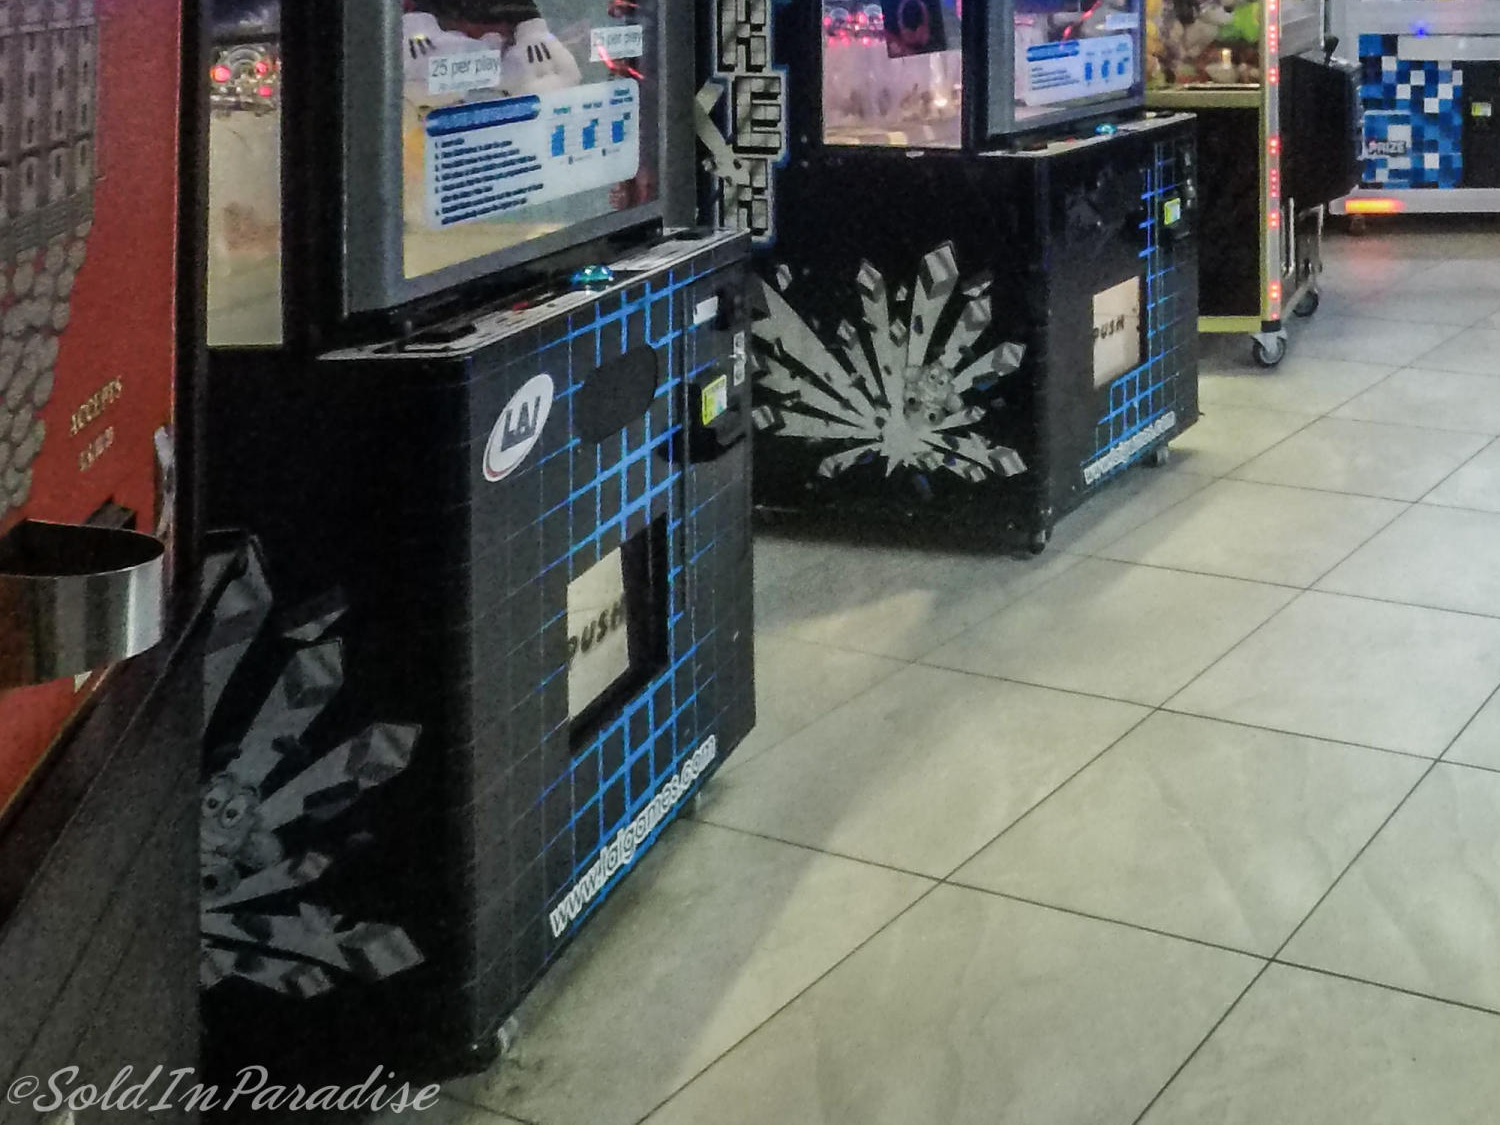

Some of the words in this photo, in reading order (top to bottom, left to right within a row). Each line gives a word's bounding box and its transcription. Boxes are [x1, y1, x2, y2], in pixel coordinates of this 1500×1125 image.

[452, 58, 471, 78] per
[475, 54, 499, 76] play
[1368, 140, 1406, 155] PRIZE
[500, 395, 541, 452] LAI
